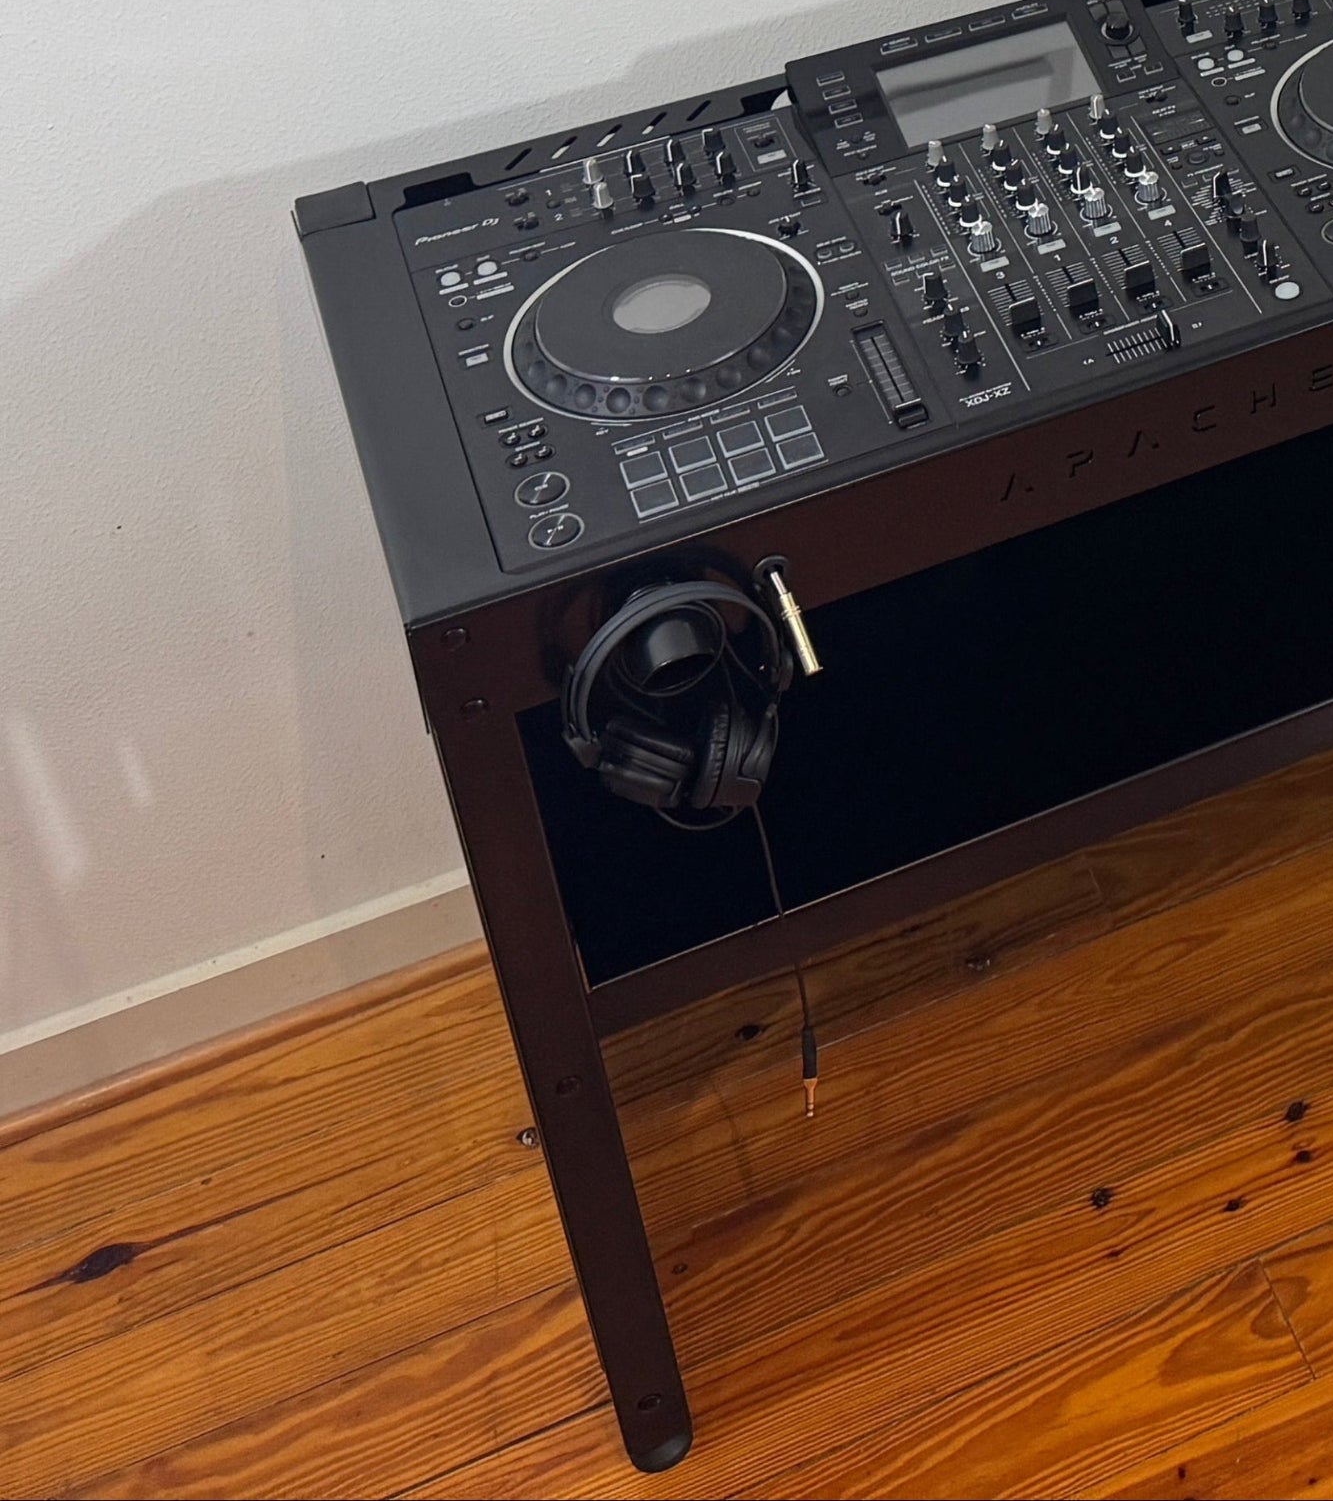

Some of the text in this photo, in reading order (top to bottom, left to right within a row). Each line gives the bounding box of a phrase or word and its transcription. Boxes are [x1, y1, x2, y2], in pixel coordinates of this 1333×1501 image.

[554, 213, 564, 221] 2
[415, 217, 500, 246] Pioneer DJ
[1109, 236, 1119, 245] 2
[995, 271, 1006, 280] 3
[965, 386, 1012, 408] XDJ-XZ
